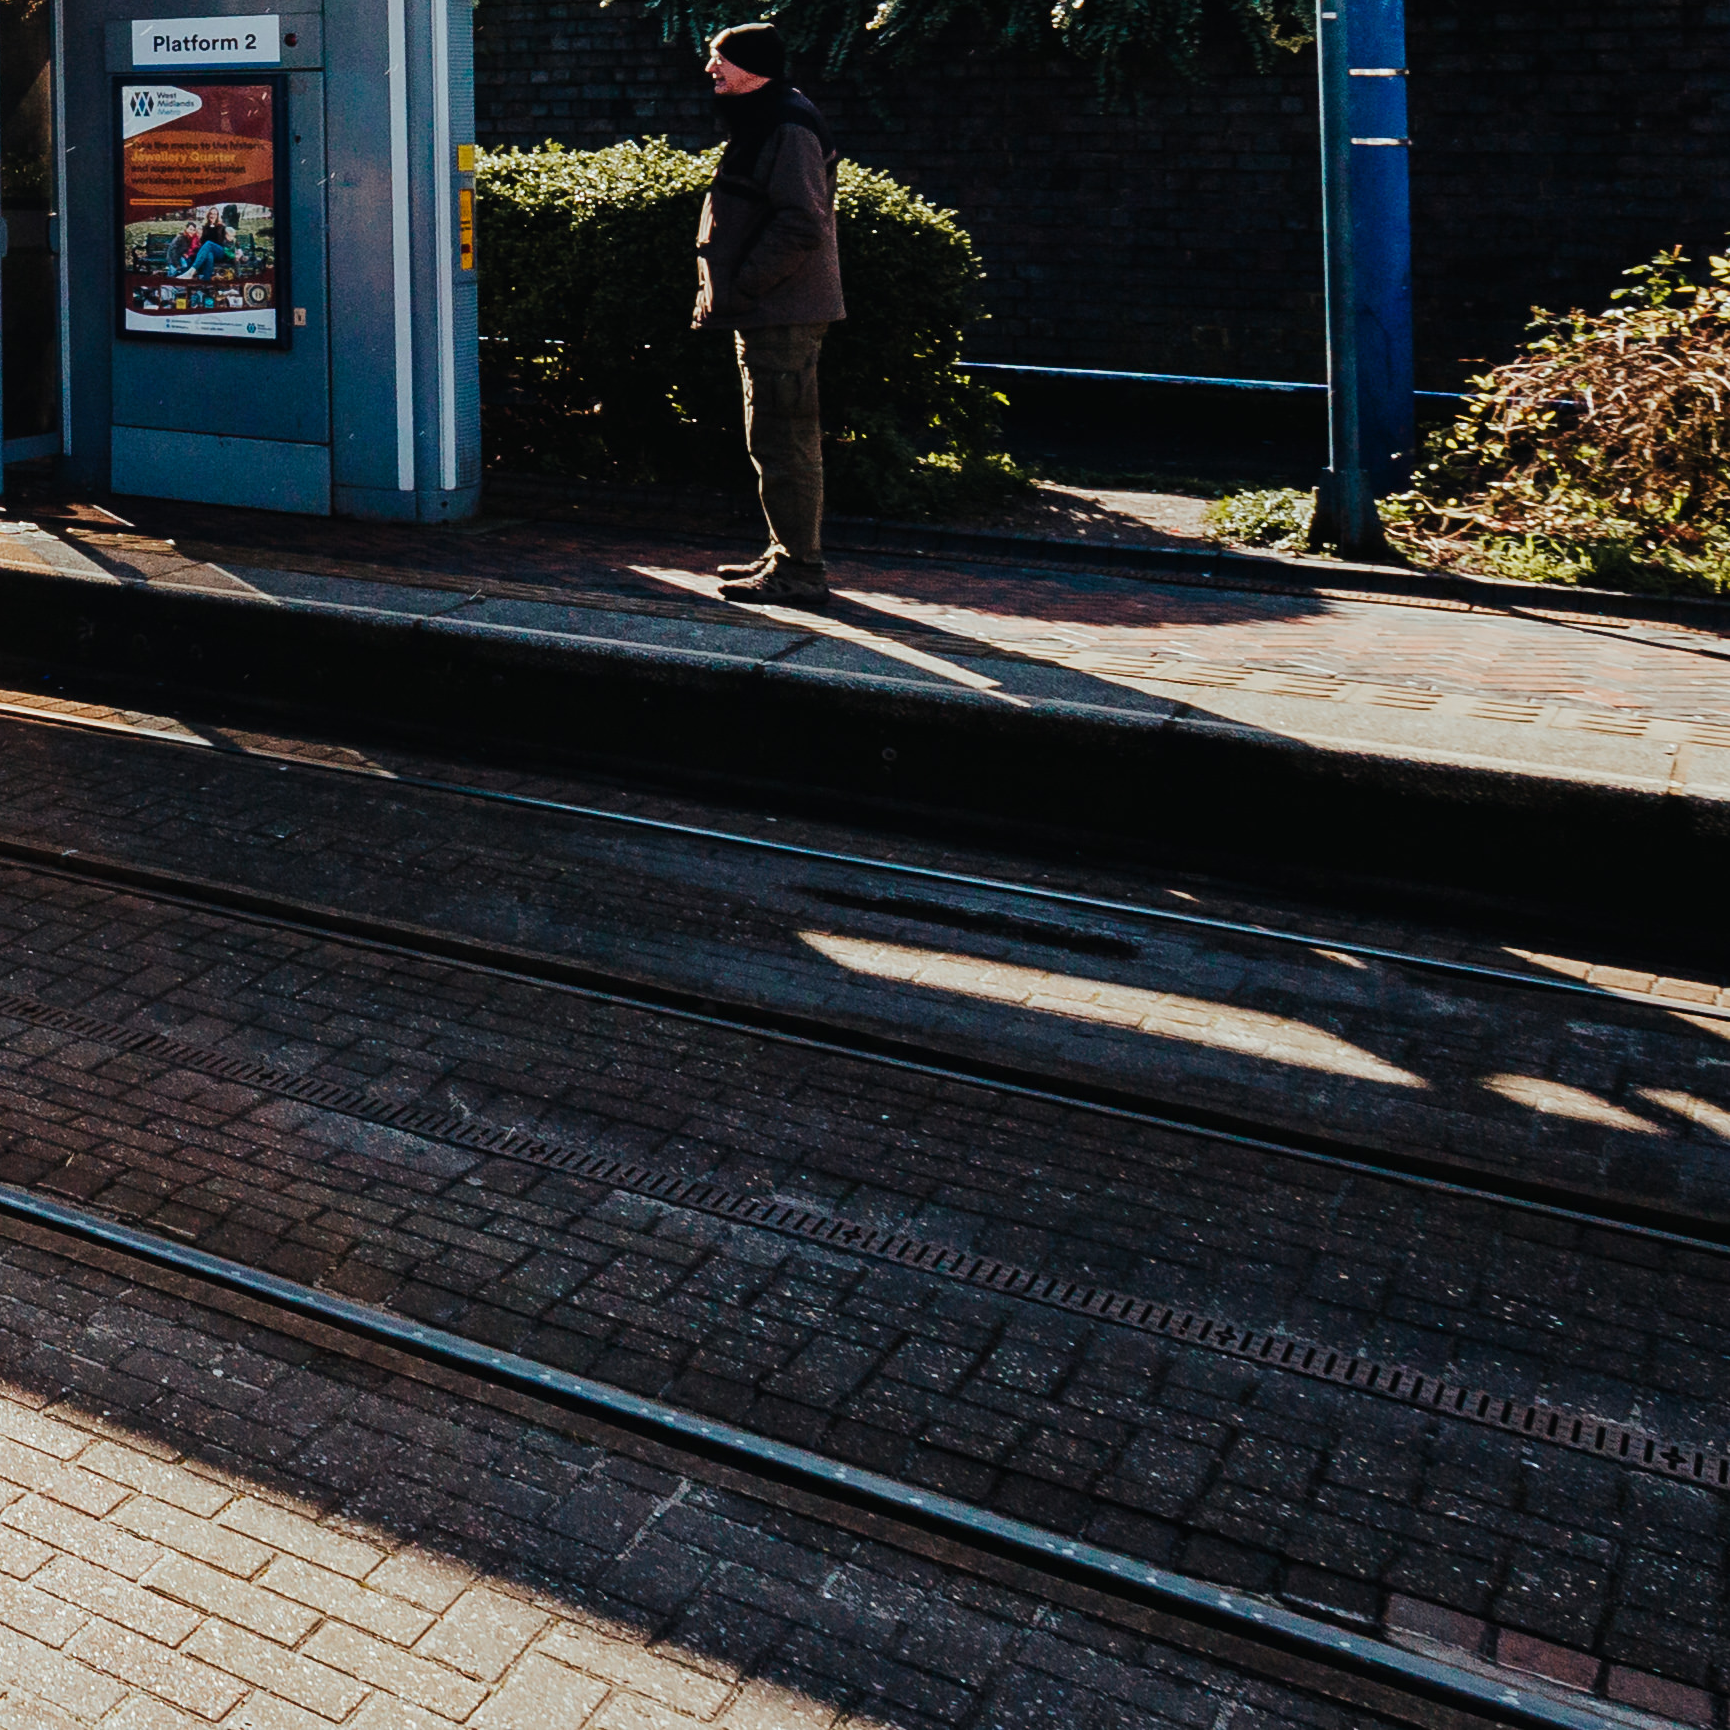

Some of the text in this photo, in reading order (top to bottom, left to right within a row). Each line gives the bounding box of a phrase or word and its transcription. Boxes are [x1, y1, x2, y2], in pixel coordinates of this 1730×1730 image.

[153, 33, 257, 52] Platform 2
[156, 92, 177, 100] West
[157, 100, 194, 108] Midlands
[131, 151, 237, 164] Jewellery Quarter
